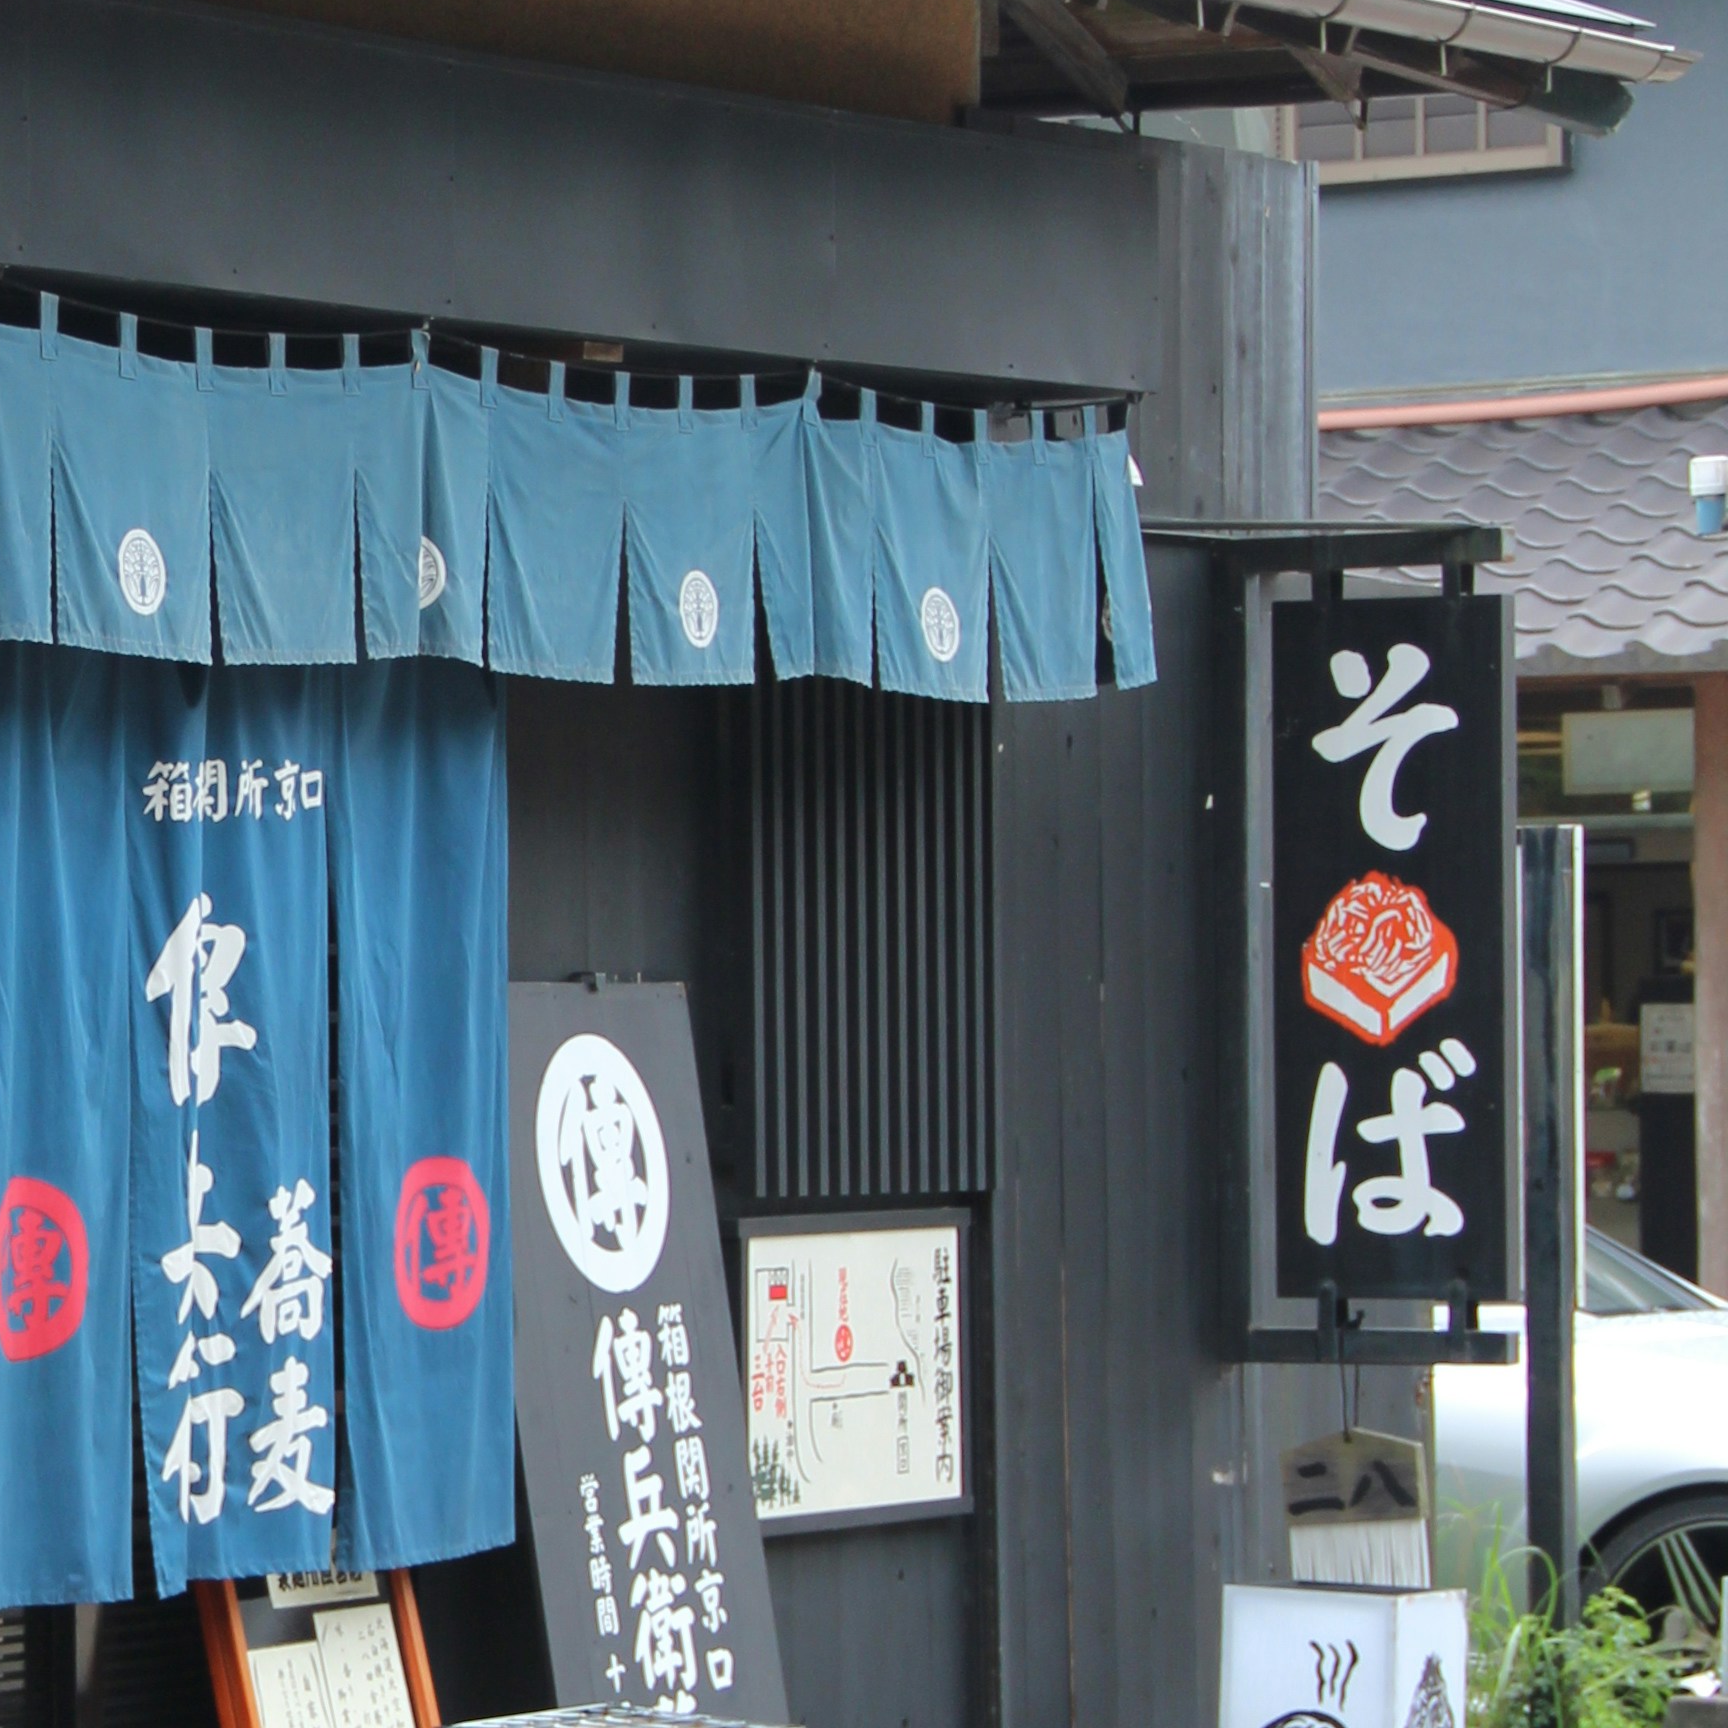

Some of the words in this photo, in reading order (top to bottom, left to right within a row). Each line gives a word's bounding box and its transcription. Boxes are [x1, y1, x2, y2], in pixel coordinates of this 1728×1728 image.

[1305, 643, 1476, 1245] そば
[240, 1178, 336, 1514] 蕎麦
[657, 1303, 734, 1691] 箱根関所京口
[1288, 1459, 1416, 1514] 二八
[579, 1473, 620, 1637] 営業時間
